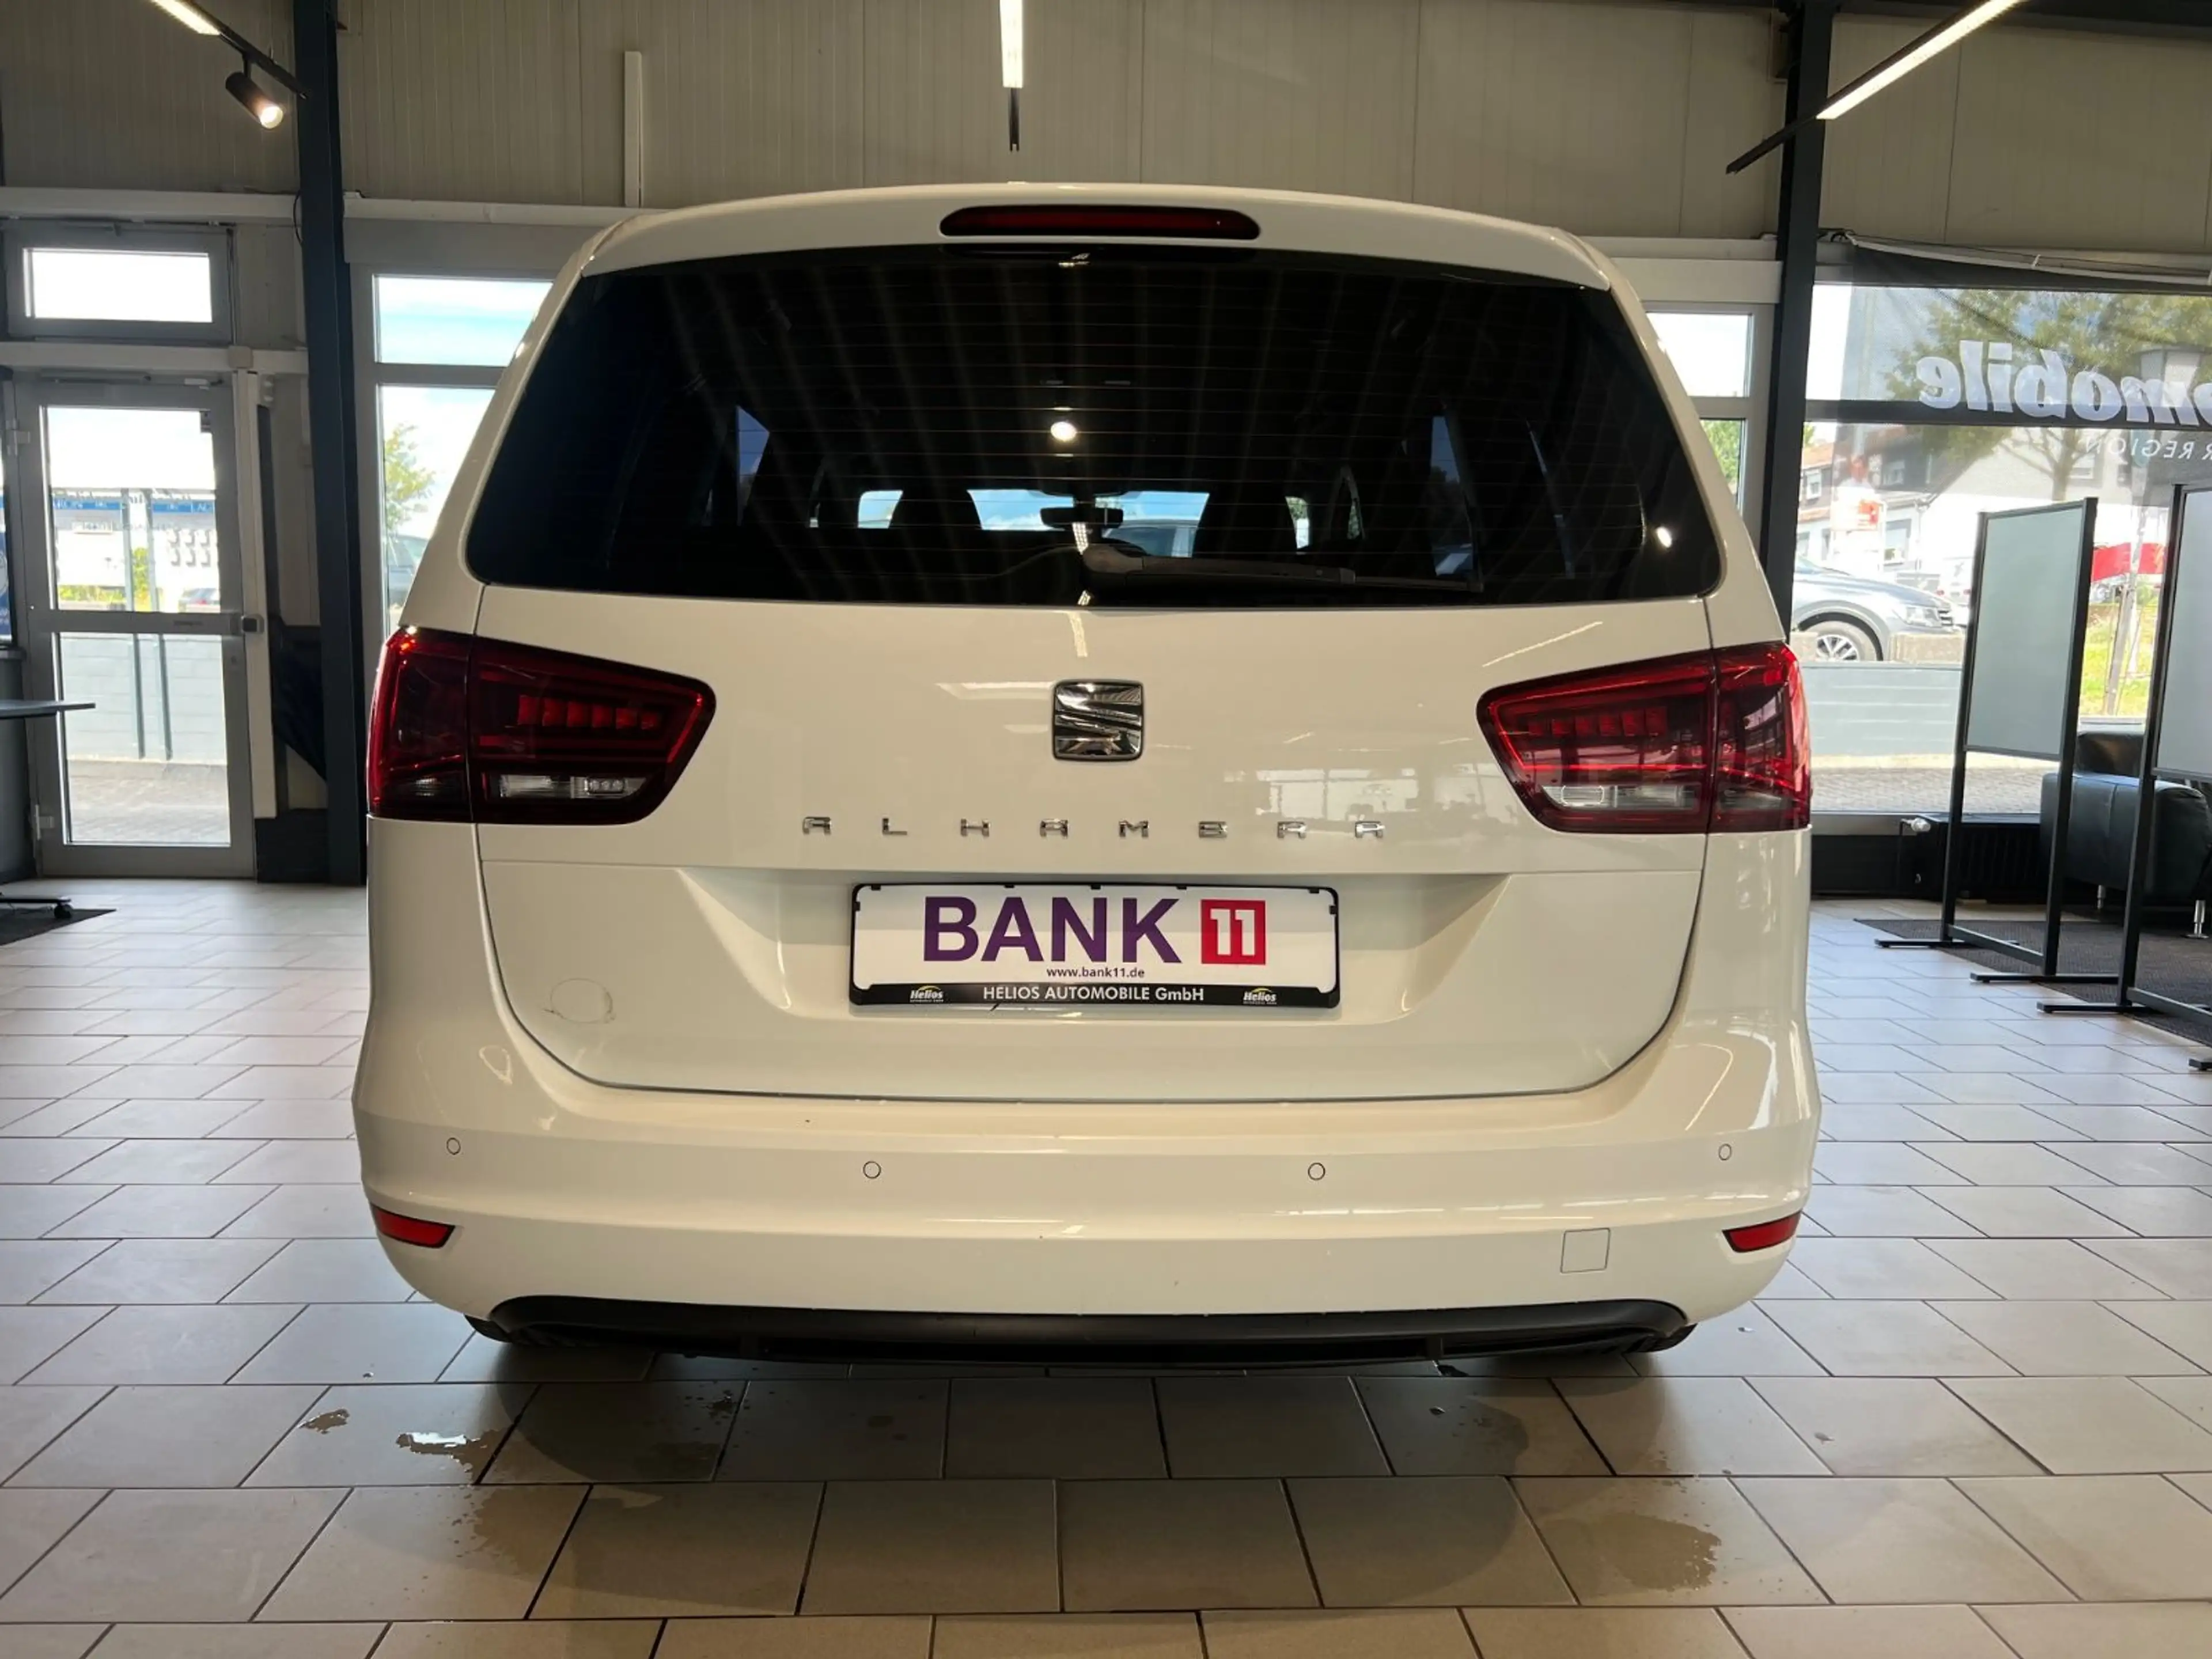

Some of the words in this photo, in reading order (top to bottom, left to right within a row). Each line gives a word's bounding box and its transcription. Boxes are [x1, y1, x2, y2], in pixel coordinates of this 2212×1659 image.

[802, 816, 1384, 838] ALHAMBRA
[923, 896, 1181, 963] BANK
[1210, 908, 1256, 956] 11
[1046, 966, 1145, 978] www.bank11.de
[910, 990, 943, 999] Helios
[983, 986, 1040, 1000] HELIOS
[1044, 986, 1150, 1001] AUTOMOBILE
[1156, 987, 1204, 1001] GmbH
[1243, 991, 1277, 1002] Helios
